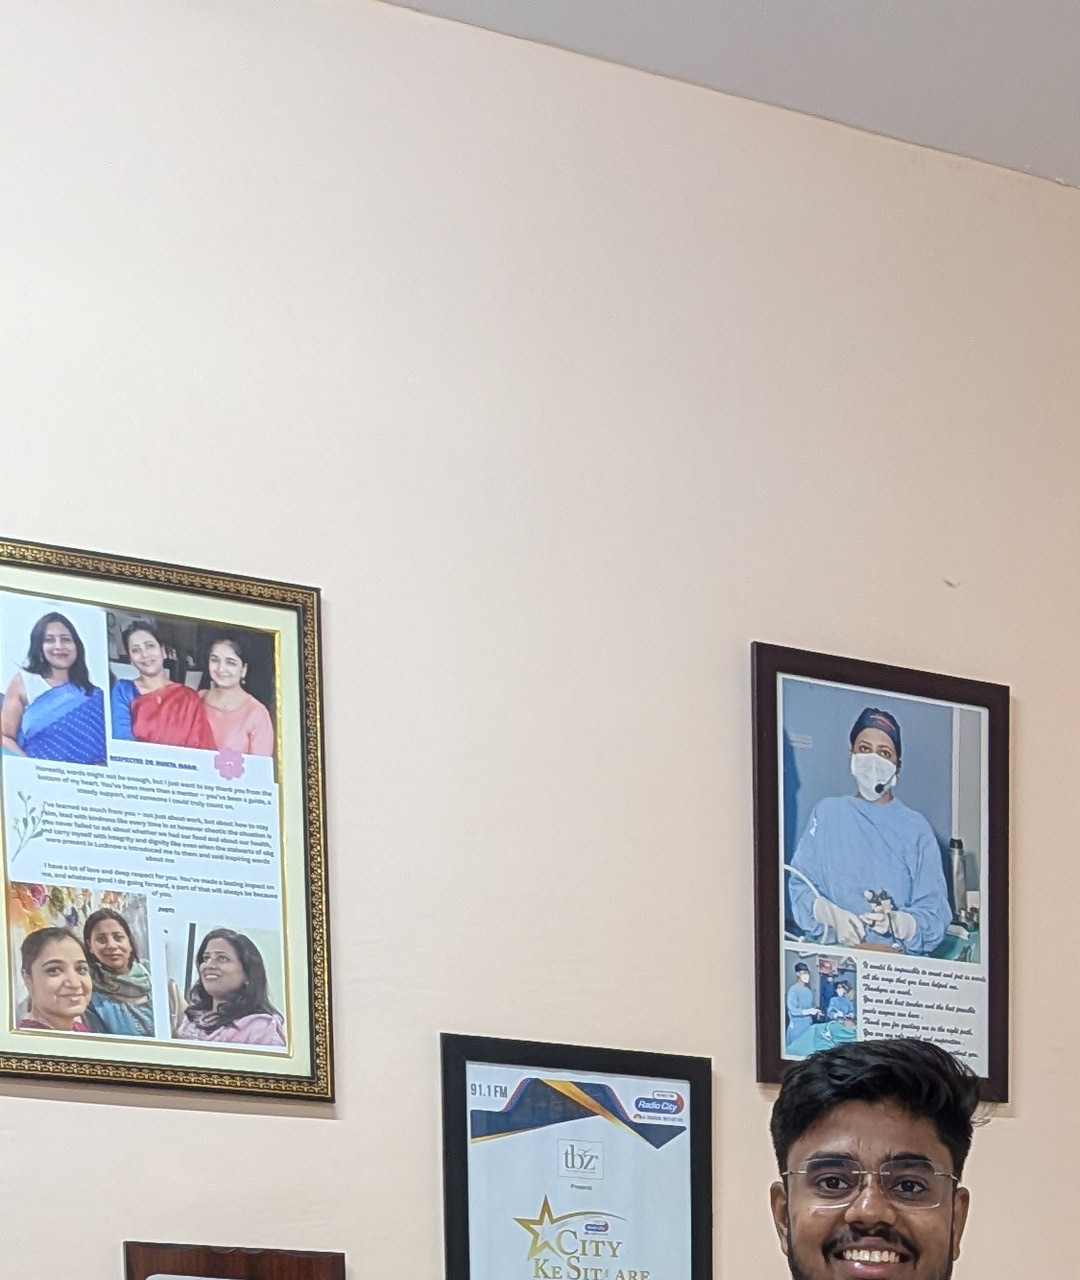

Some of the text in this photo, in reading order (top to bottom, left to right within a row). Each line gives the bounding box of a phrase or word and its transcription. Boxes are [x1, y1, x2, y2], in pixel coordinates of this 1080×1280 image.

[470, 1083, 508, 1099] 91.1 FM
[637, 1100, 678, 1113] Radio City
[556, 1229, 622, 1258] CITY
[533, 1258, 563, 1279] KE
